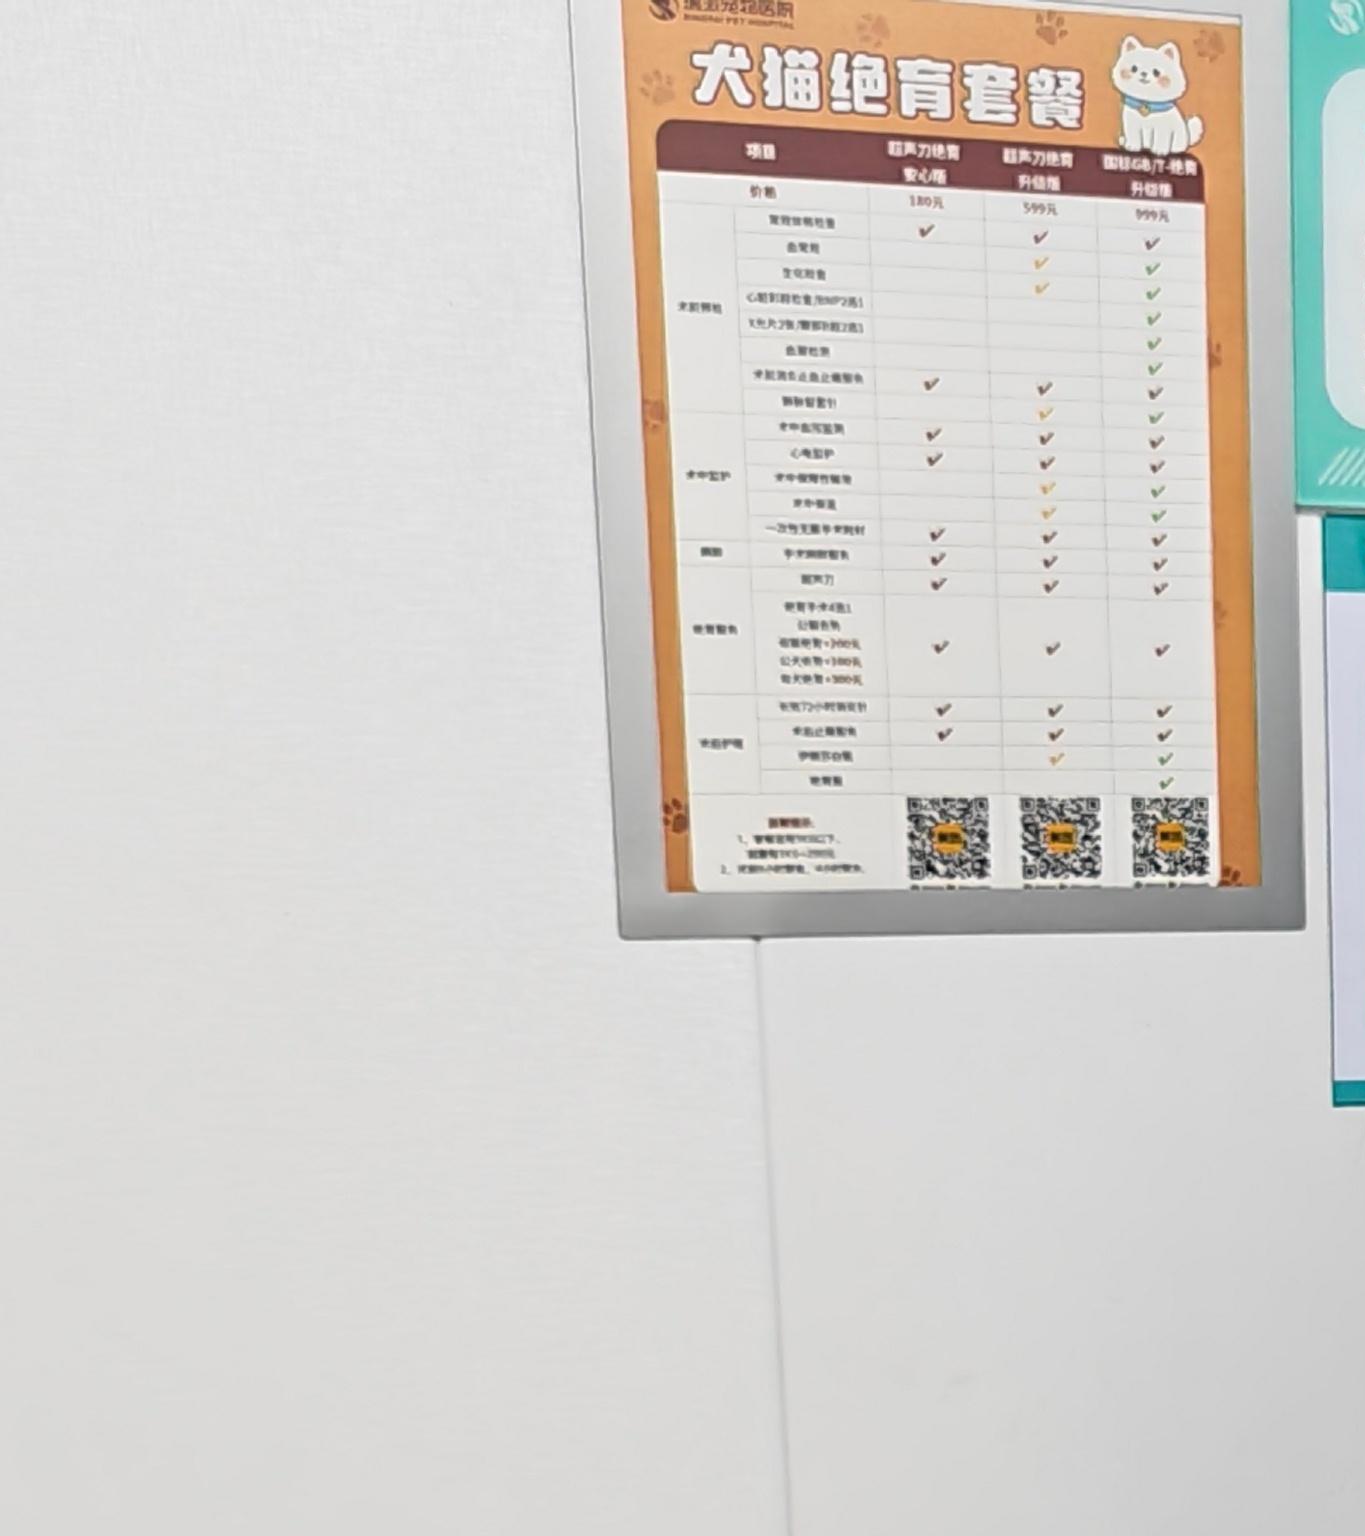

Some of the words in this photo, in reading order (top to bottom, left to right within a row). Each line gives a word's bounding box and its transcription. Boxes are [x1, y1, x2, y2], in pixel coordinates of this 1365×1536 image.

[691, 41, 1084, 130] 犬猫绝育套餐
